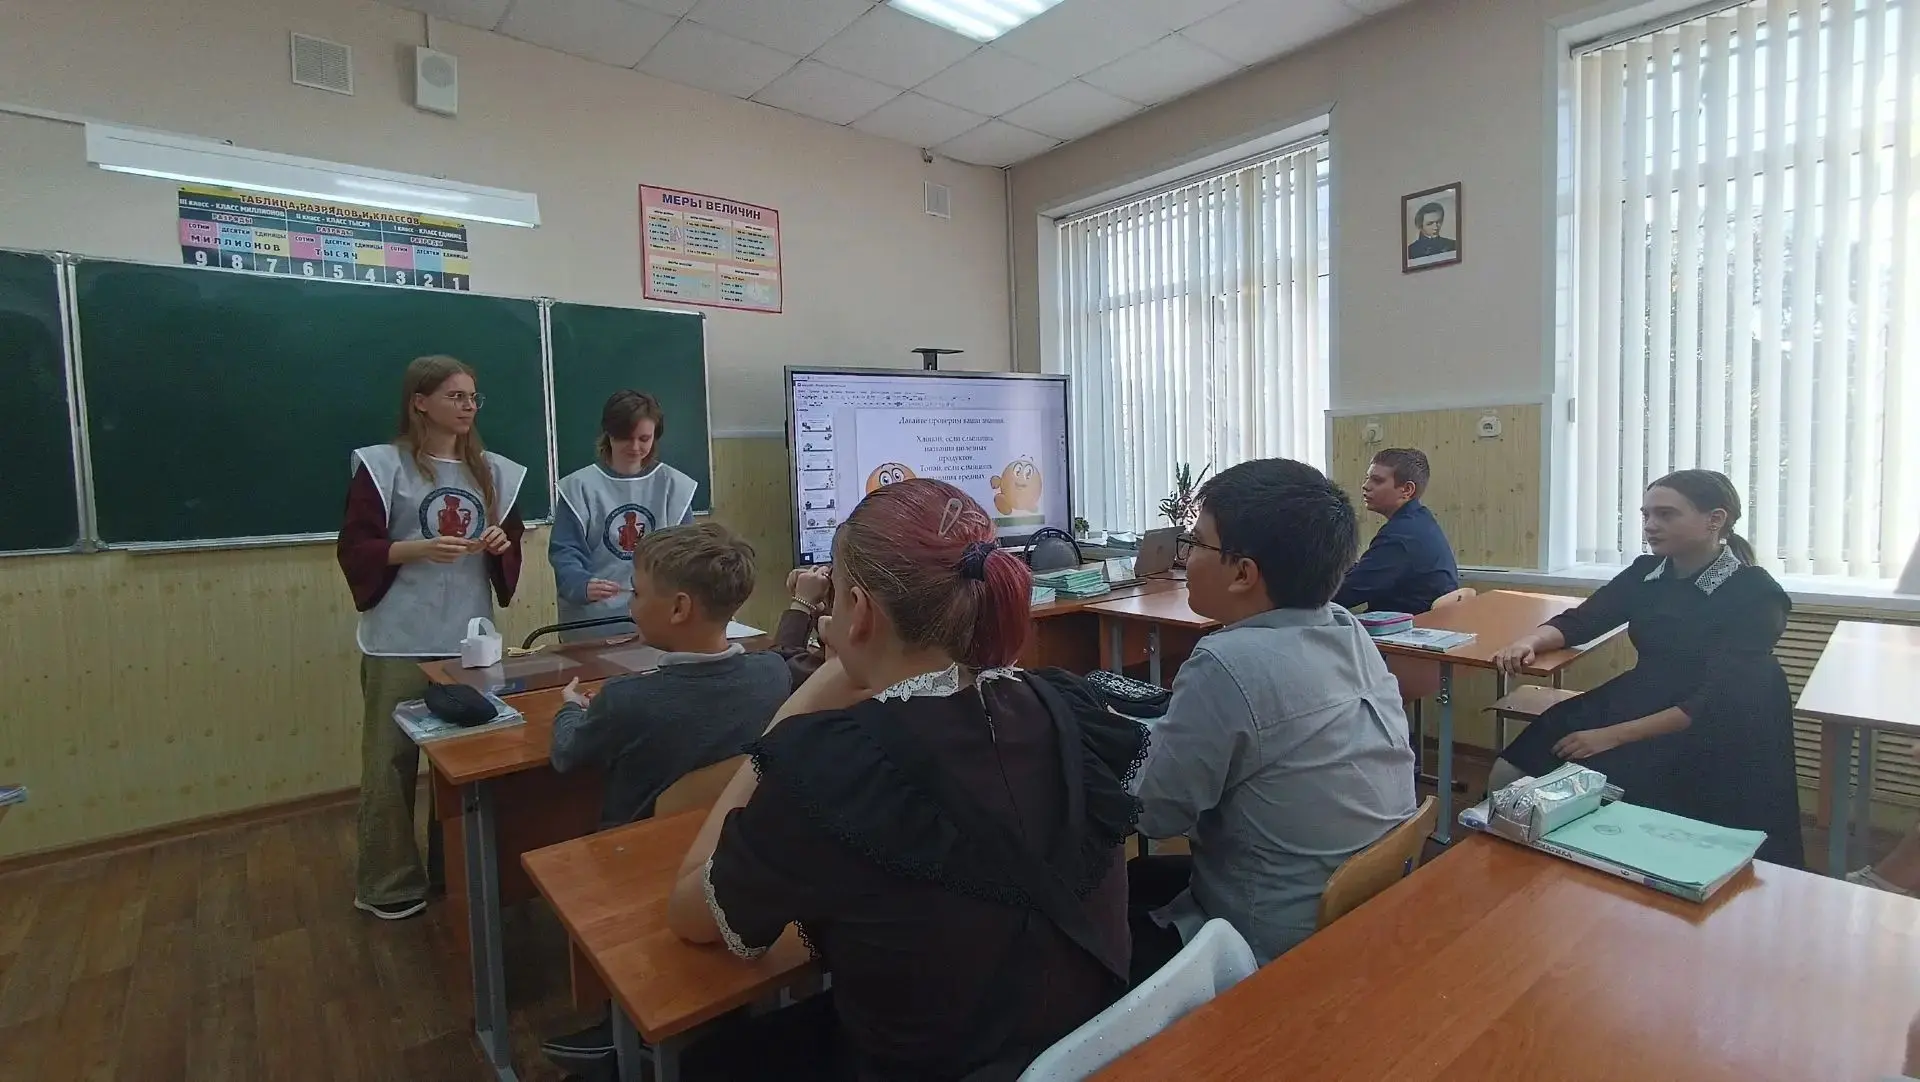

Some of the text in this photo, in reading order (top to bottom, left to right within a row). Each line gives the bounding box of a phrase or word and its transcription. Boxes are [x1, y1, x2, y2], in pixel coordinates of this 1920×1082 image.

[240, 194, 420, 225] ТАБЛИЦА РАЗРЯДОВ И КЛАССОВ
[662, 193, 761, 220] МЕРЫ ВЕЛИЧИН
[212, 213, 253, 224] РАЗРЯДЫ
[221, 227, 250, 235] ДЕСЯТКИ
[317, 226, 353, 236] РАЗРЯДЫ
[195, 251, 460, 291] 9 8 7 6 5 4 3 2 1
